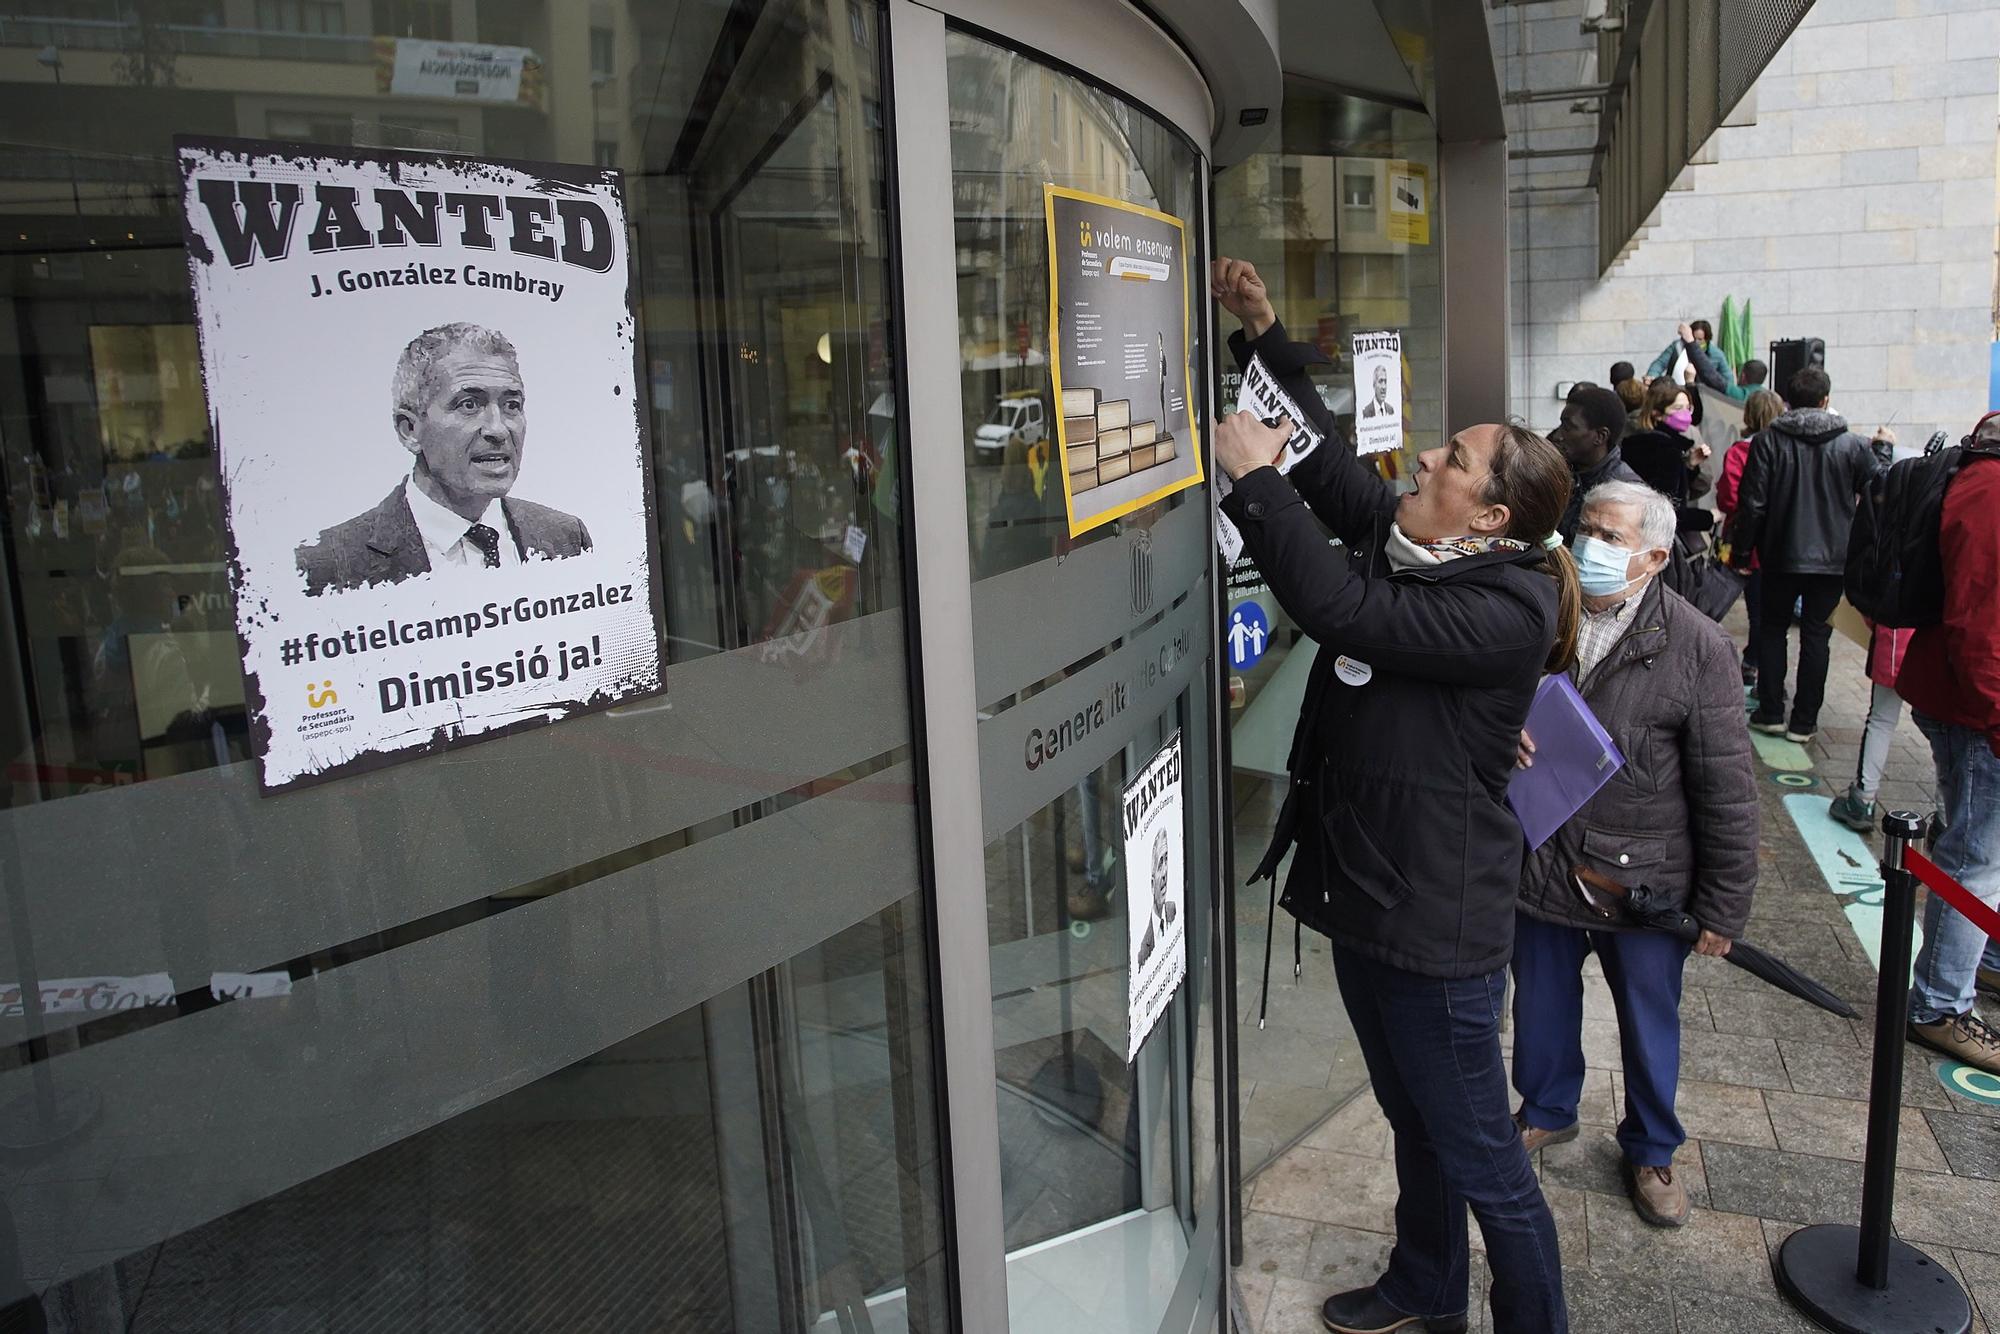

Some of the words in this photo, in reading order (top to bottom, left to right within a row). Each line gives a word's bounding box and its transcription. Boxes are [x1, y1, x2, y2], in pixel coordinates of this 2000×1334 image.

[198, 179, 615, 272] WANTED
[1096, 225, 1132, 253] volem
[310, 272, 332, 298] J.
[339, 262, 456, 293] González
[463, 265, 563, 302] Cambray
[1355, 337, 1398, 355] WANTED
[280, 583, 633, 666] #fotielcampSrGonzalez
[378, 645, 549, 714] Dimissió
[557, 636, 603, 681] ja!
[302, 708, 347, 722] Professors
[1126, 750, 1179, 838] WANTED
